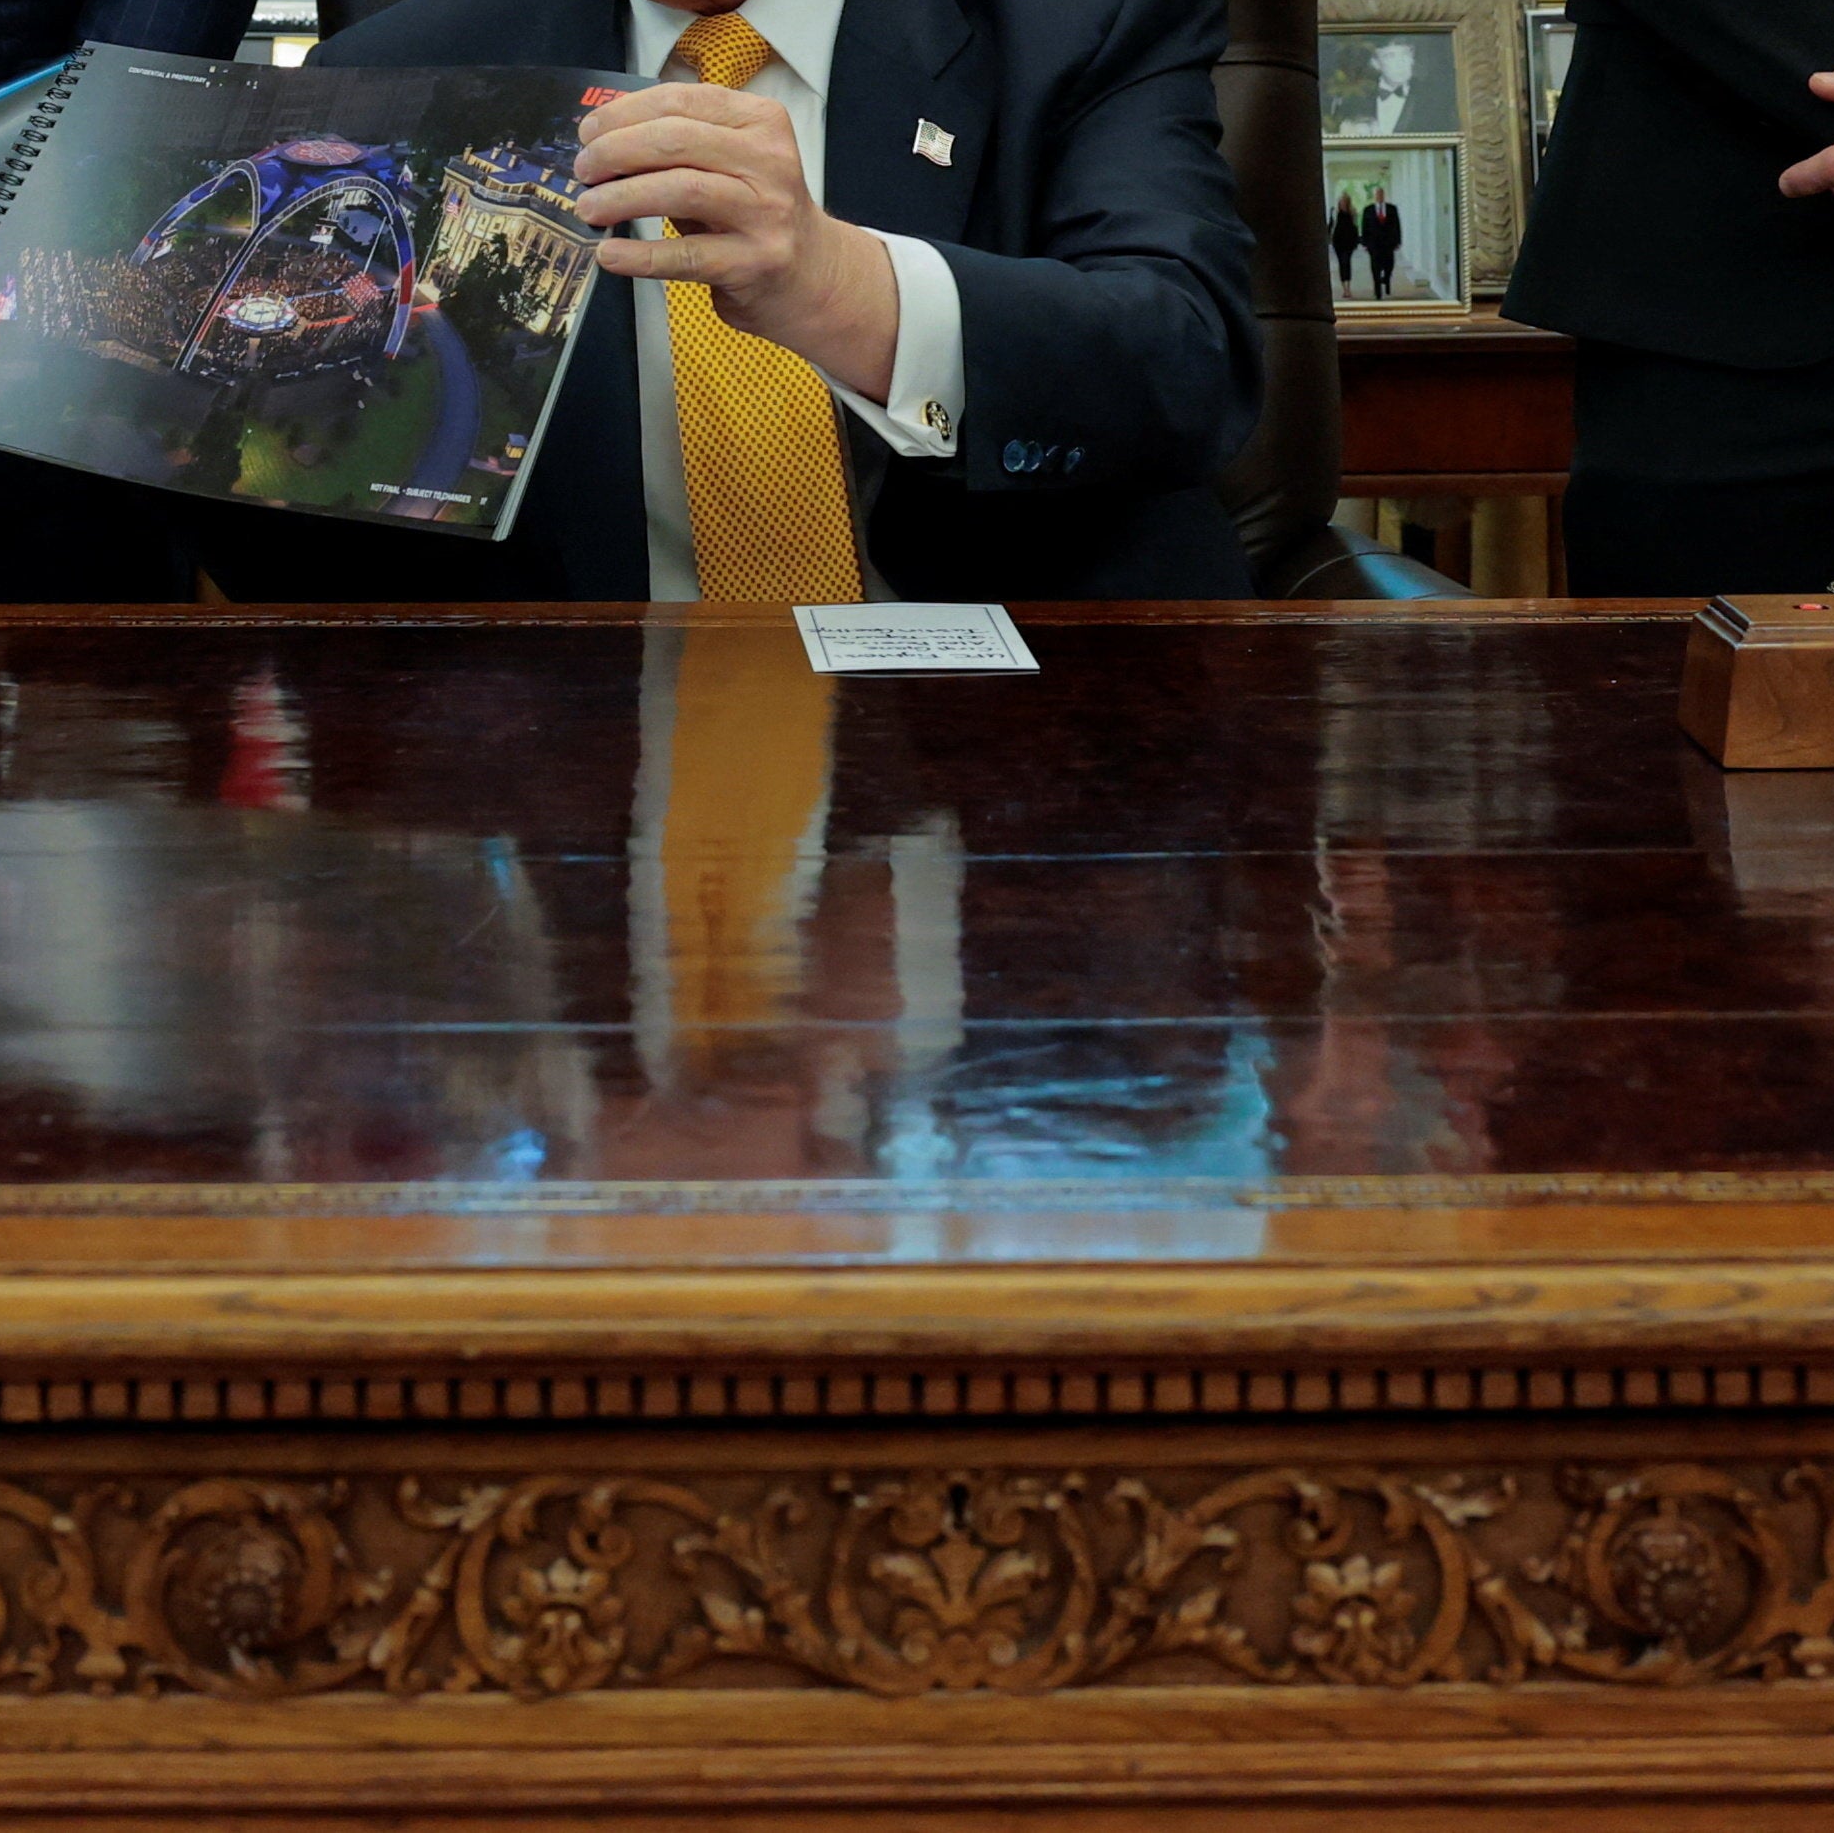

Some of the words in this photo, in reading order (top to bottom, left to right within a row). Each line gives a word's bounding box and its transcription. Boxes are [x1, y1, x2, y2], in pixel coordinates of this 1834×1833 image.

[128, 66, 165, 78] CONFIDENTIAL
[171, 73, 207, 83] PROPRIETARY
[370, 483, 383, 492] NOT
[383, 484, 400, 494] FINAL
[405, 488, 433, 498] SUBJECT
